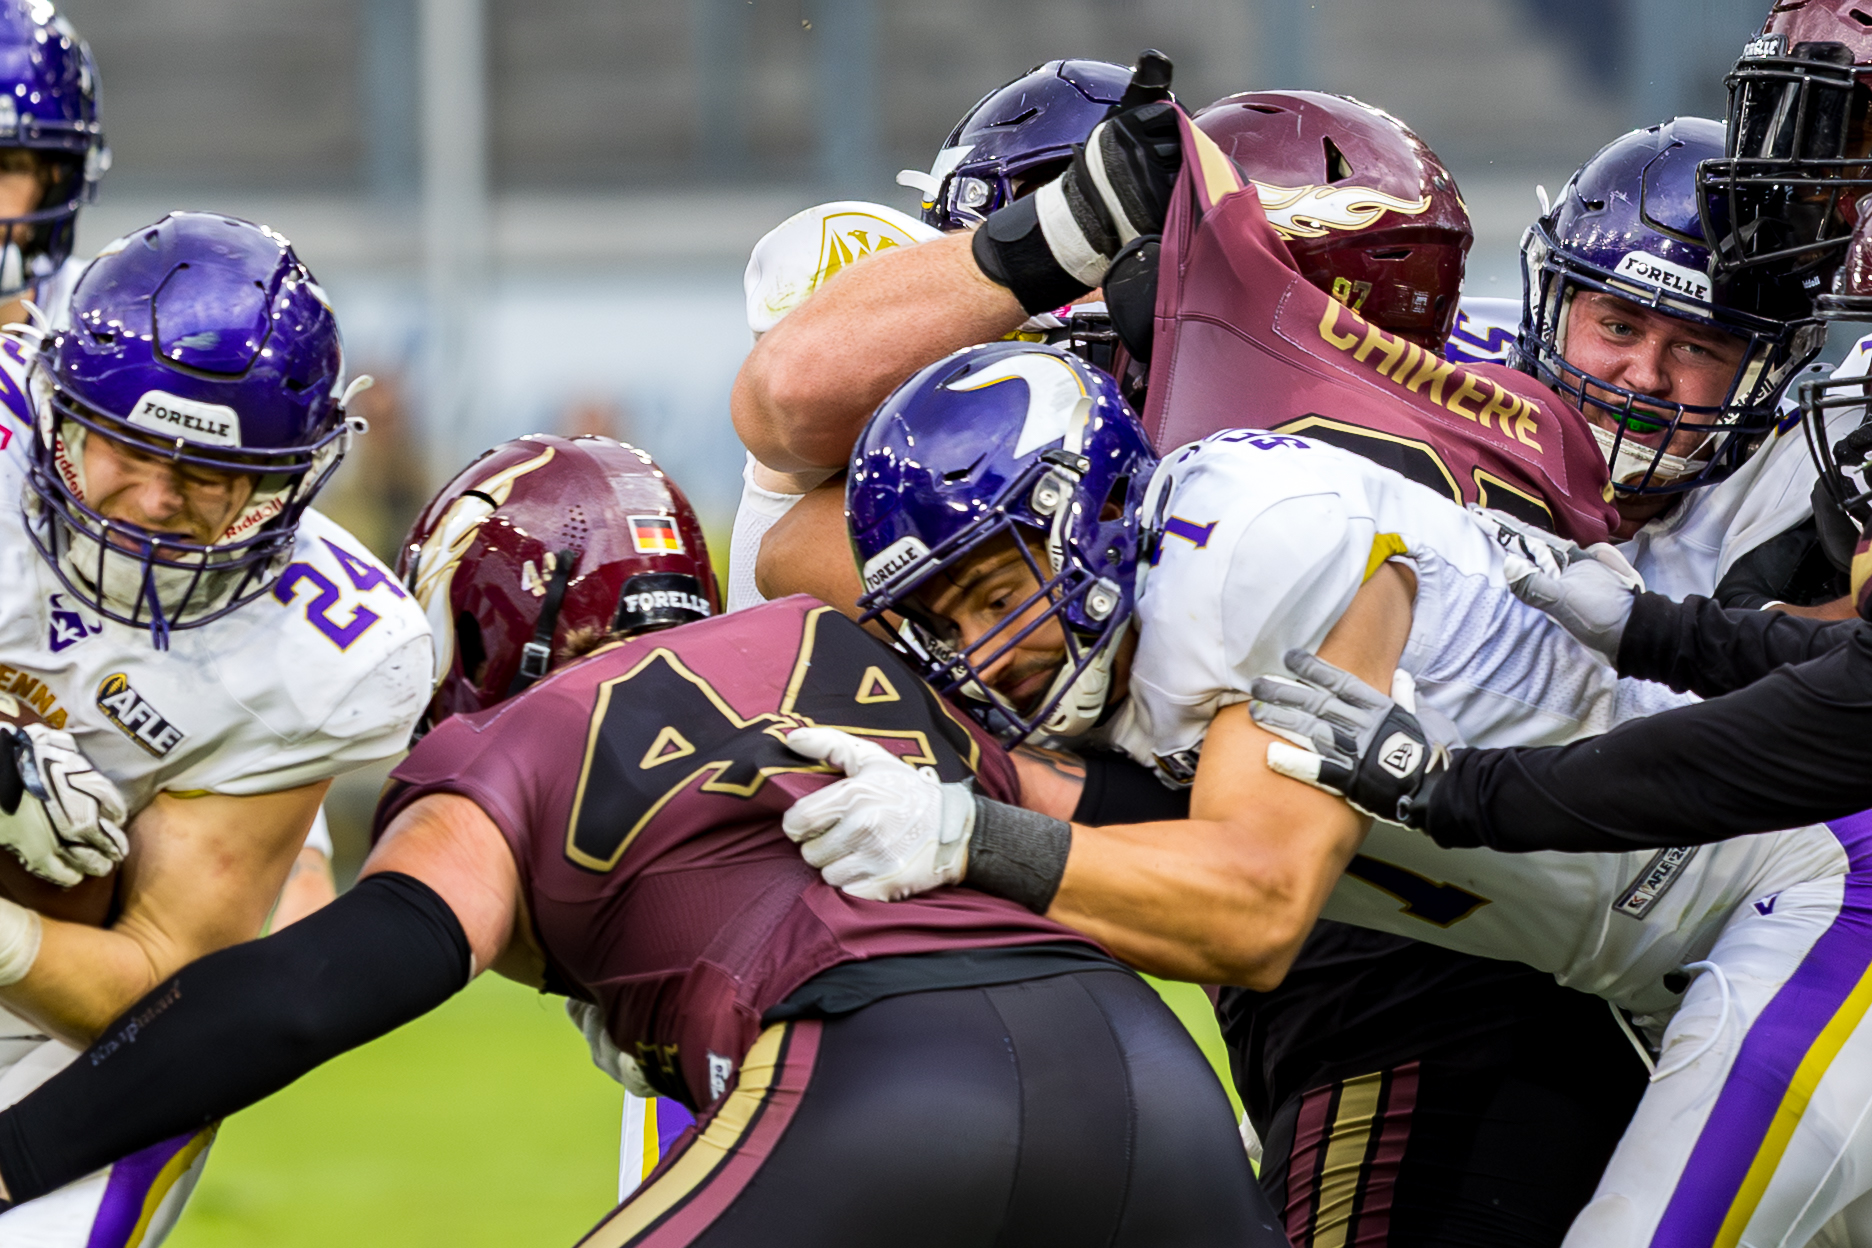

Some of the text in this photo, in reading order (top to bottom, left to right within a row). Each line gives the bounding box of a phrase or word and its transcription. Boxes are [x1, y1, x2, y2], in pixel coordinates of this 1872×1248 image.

[1625, 257, 1708, 300] FORELLE
[1318, 295, 1545, 455] CHIKERE
[142, 402, 231, 438] FORELLE
[272, 536, 409, 654] 24
[623, 591, 711, 617] FORELLE
[101, 688, 182, 754] AFLE
[1646, 860, 1672, 891] AFLE
